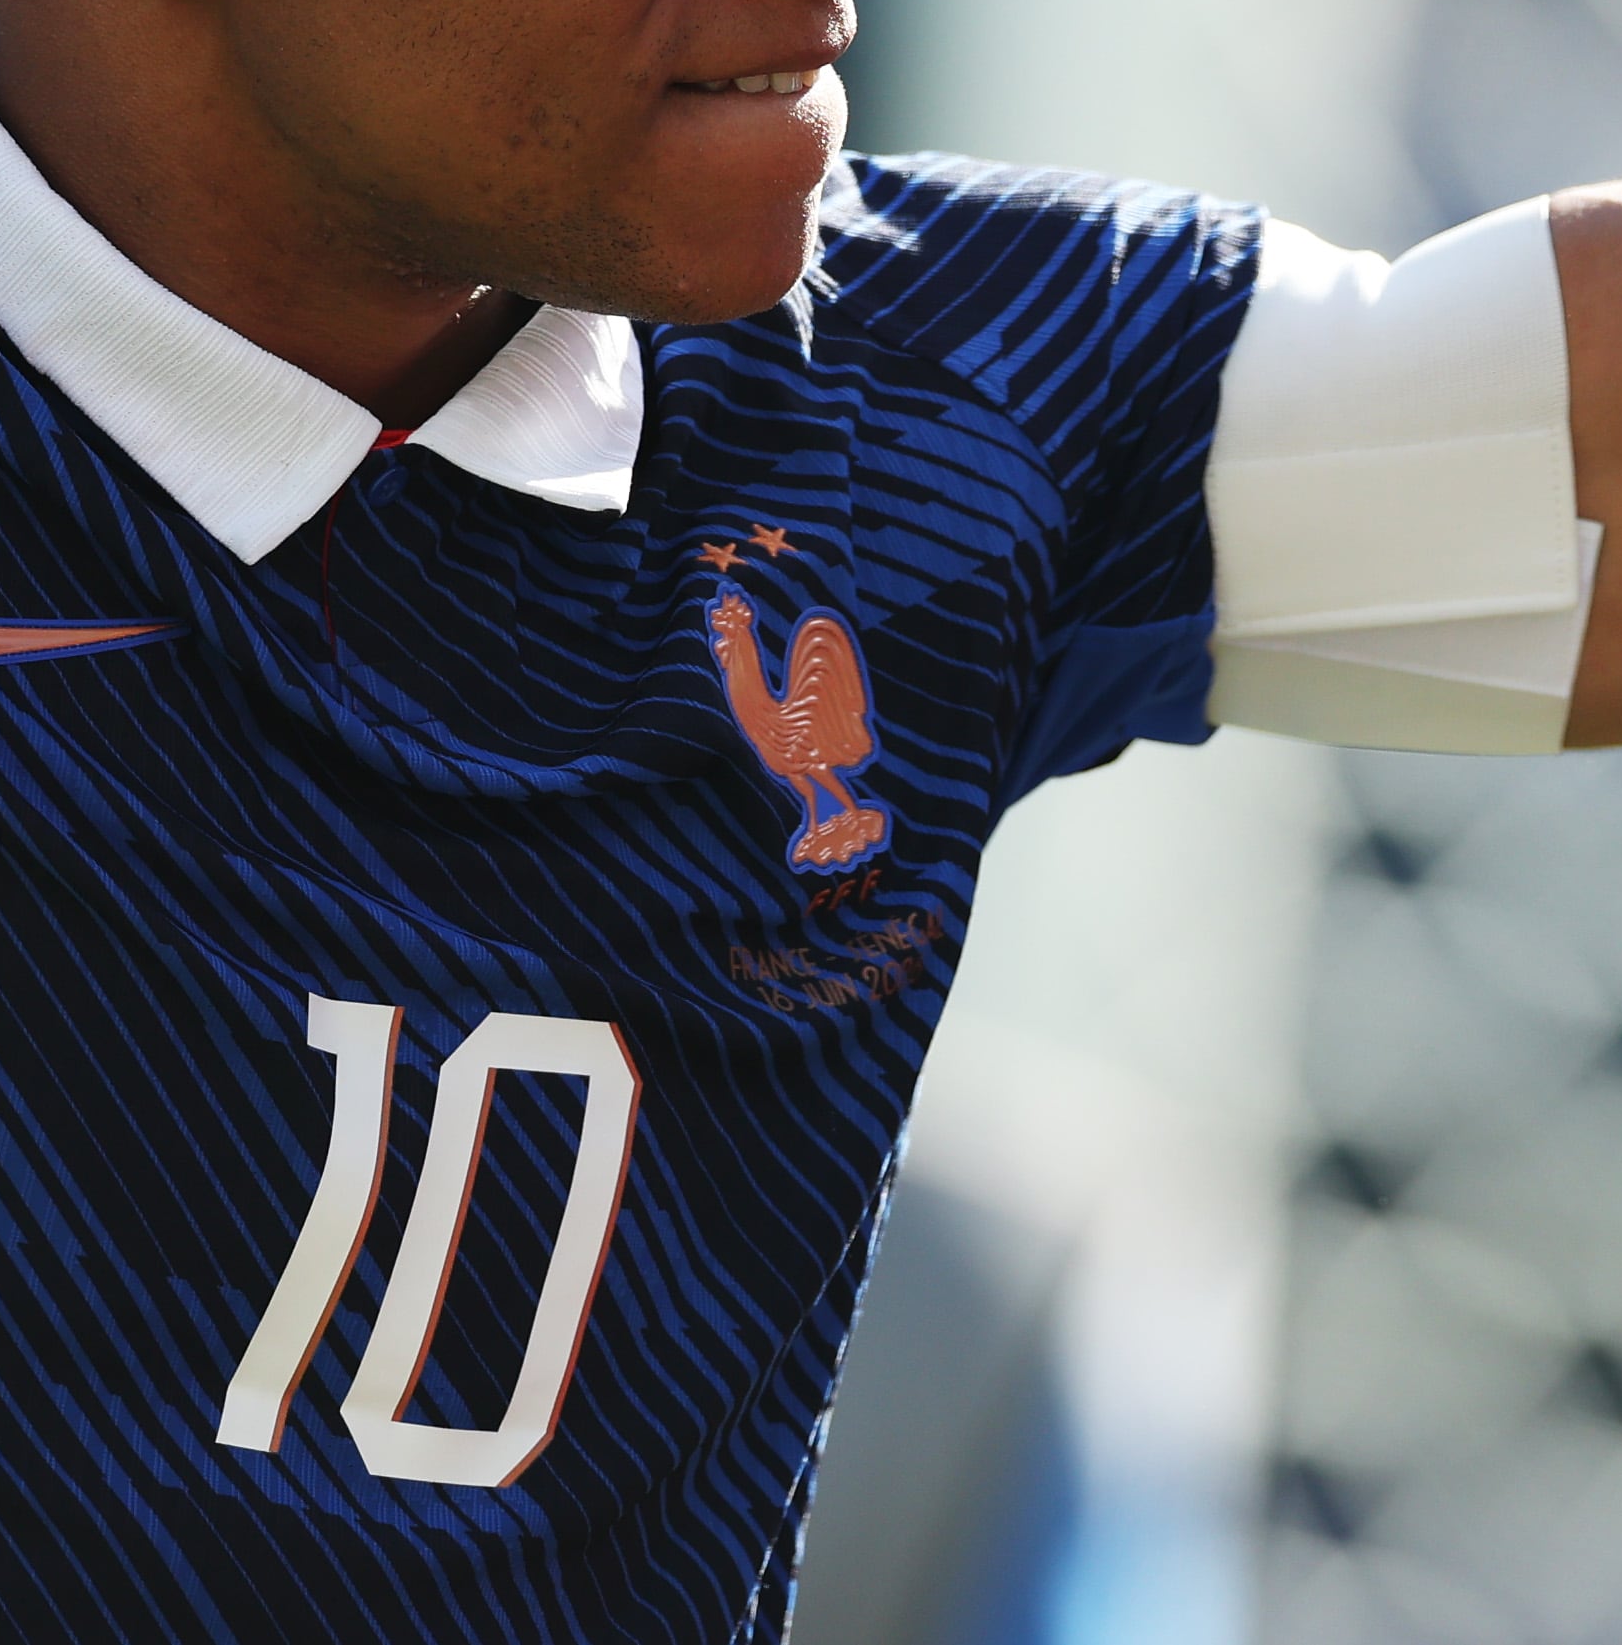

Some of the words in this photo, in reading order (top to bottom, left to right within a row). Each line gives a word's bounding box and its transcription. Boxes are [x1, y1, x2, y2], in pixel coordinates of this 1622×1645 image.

[729, 946, 819, 981] FRANCE
[756, 985, 795, 1012] 16
[802, 972, 859, 1010] JUIN
[215, 991, 643, 1489] 10
